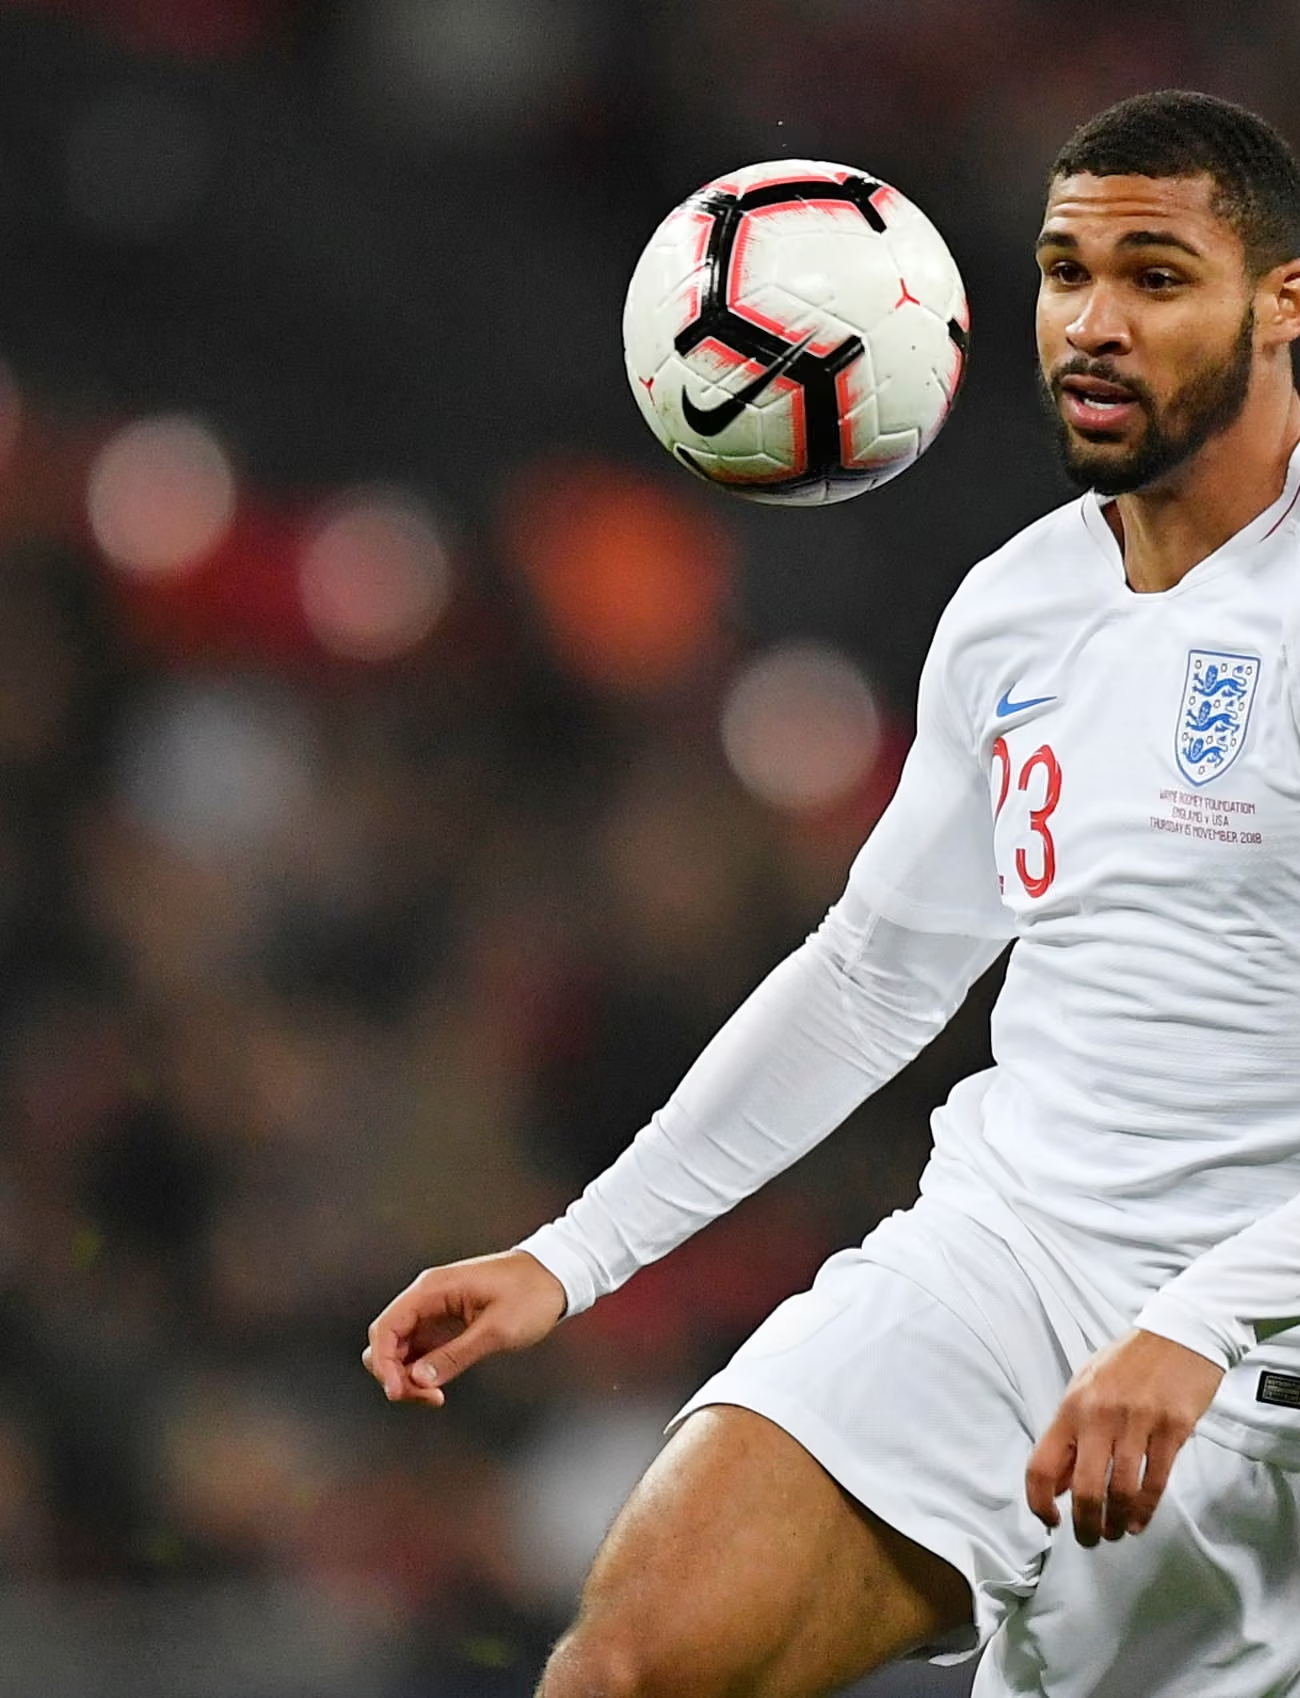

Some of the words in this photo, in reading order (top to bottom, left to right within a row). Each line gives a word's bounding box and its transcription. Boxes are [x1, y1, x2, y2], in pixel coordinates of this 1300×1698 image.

[1204, 797, 1255, 815] FOUNDATION
[1172, 806, 1203, 823] ENGLAND
[1212, 813, 1229, 827] USA
[1192, 826, 1238, 843] NOVEMBER
[1240, 832, 1262, 844] 2018
